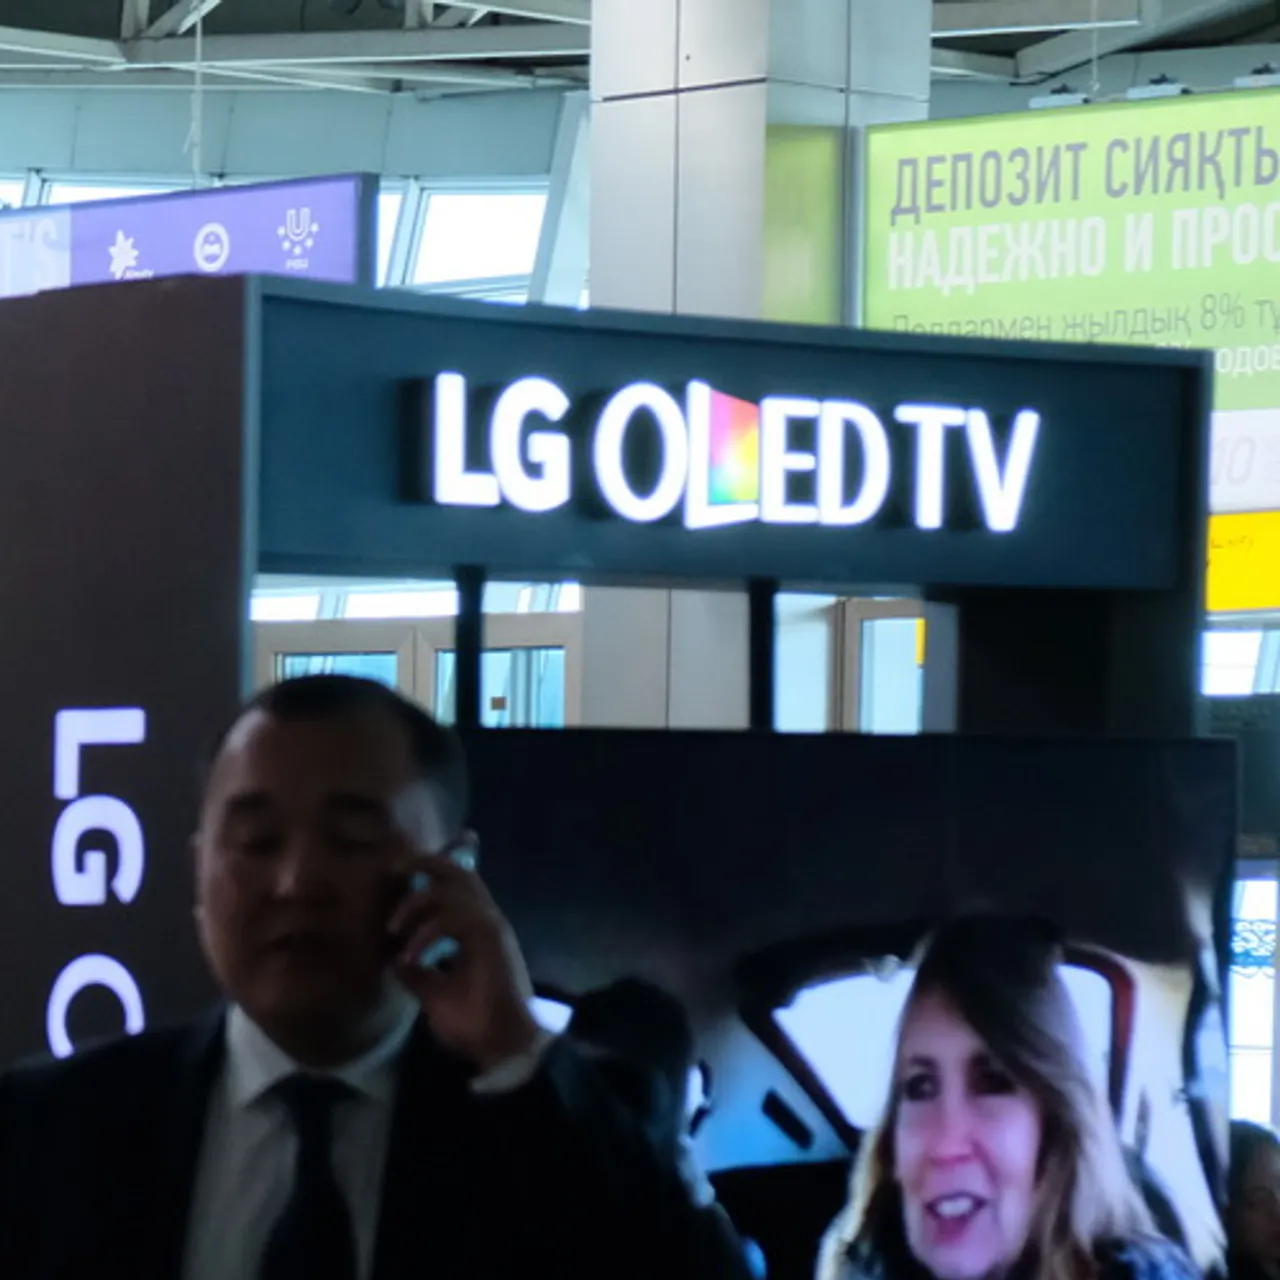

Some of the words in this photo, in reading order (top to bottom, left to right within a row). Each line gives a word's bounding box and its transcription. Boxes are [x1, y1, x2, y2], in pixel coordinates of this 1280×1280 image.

[890, 142, 1088, 226] ДЕПОЗИТ
[887, 216, 1107, 298] НАДЕЖНО
[1123, 212, 1154, 273] И
[1200, 293, 1246, 331] 8%
[432, 370, 573, 514] LG
[592, 377, 891, 531] OLED
[894, 402, 1041, 533] TV
[50, 706, 146, 906] LG
